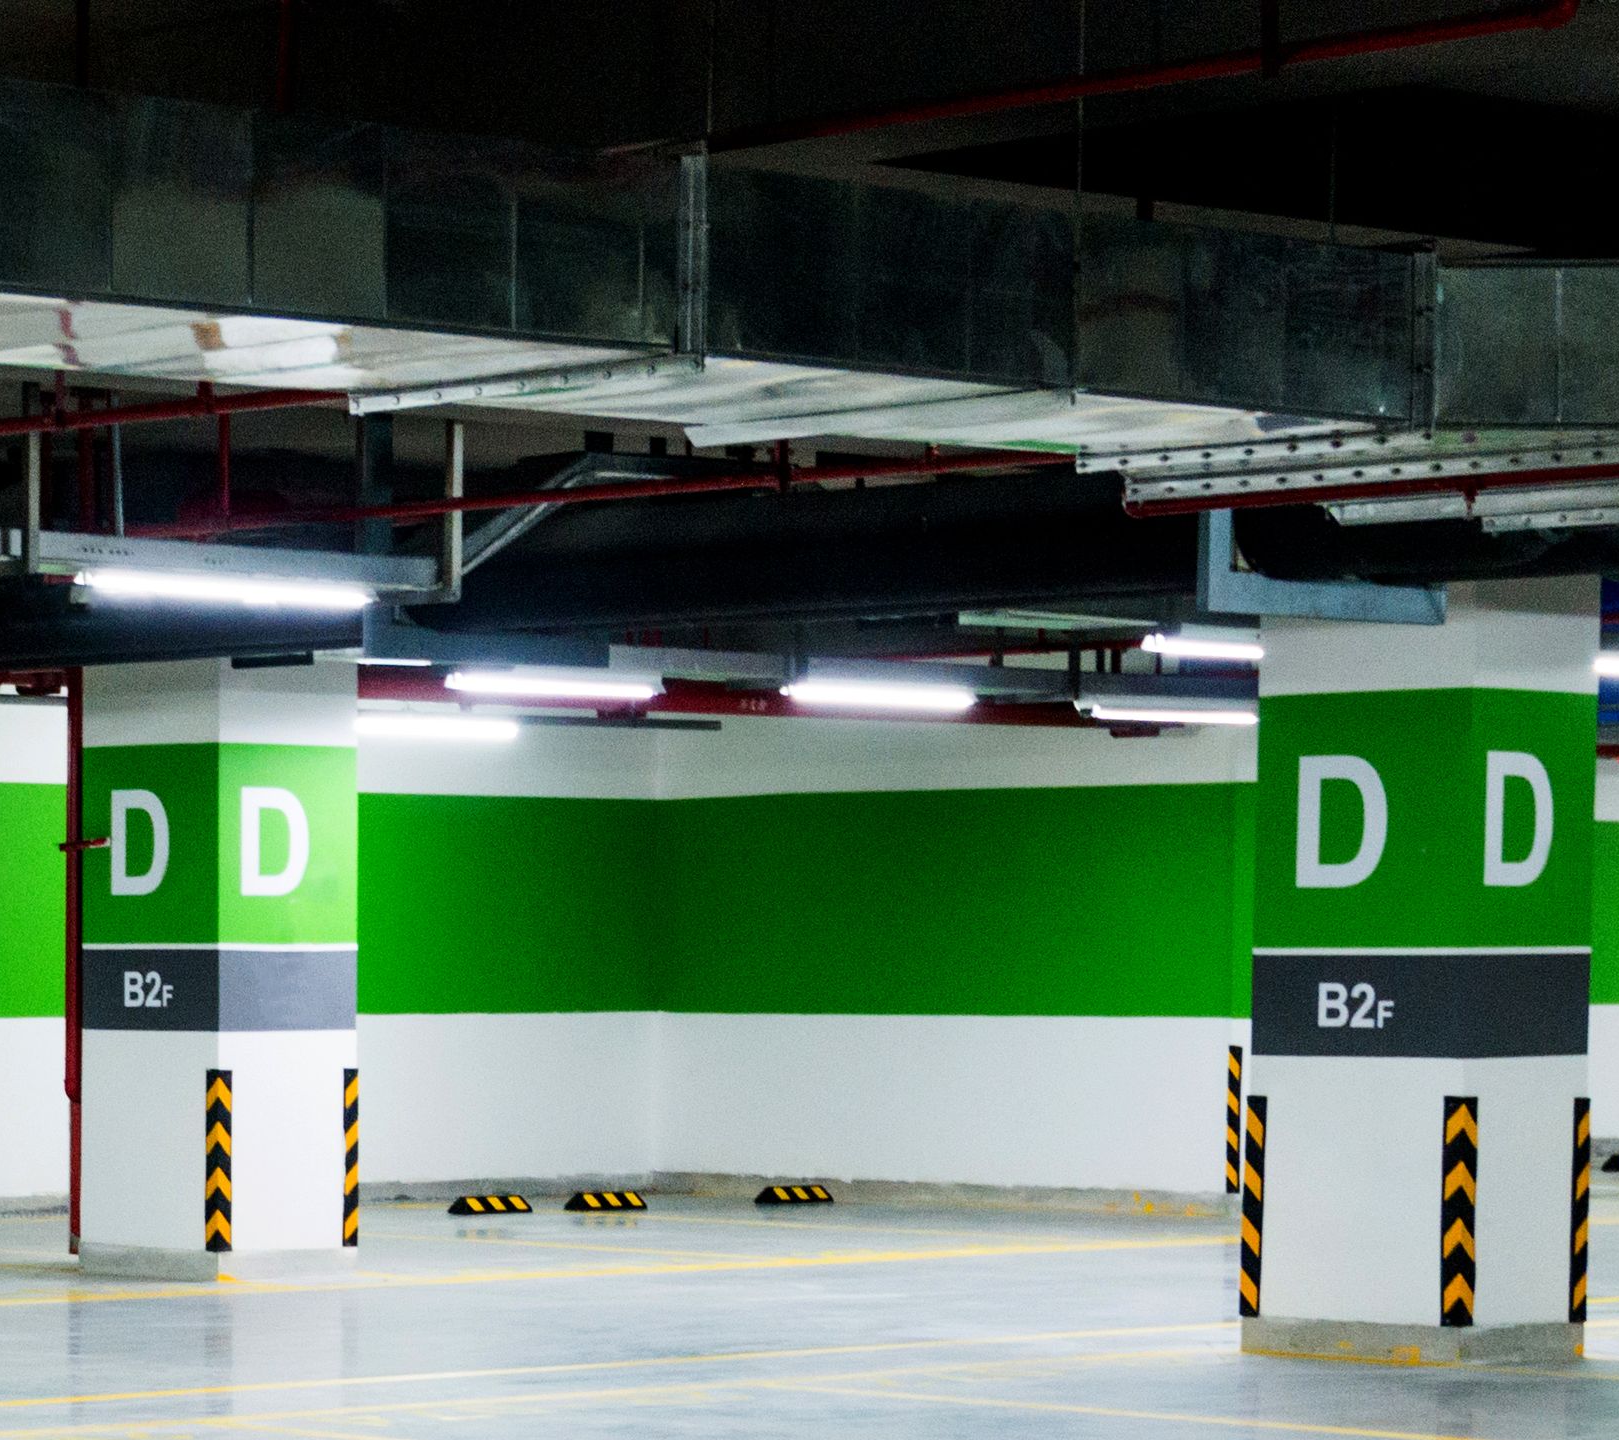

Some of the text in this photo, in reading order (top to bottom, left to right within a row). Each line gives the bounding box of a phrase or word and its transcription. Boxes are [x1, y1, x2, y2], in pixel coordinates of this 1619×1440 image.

[110, 789, 169, 894] D
[240, 786, 310, 896] D
[1296, 755, 1387, 887] D
[1484, 751, 1553, 886] D
[123, 970, 173, 1008] B2F
[1317, 982, 1394, 1029] B2F
